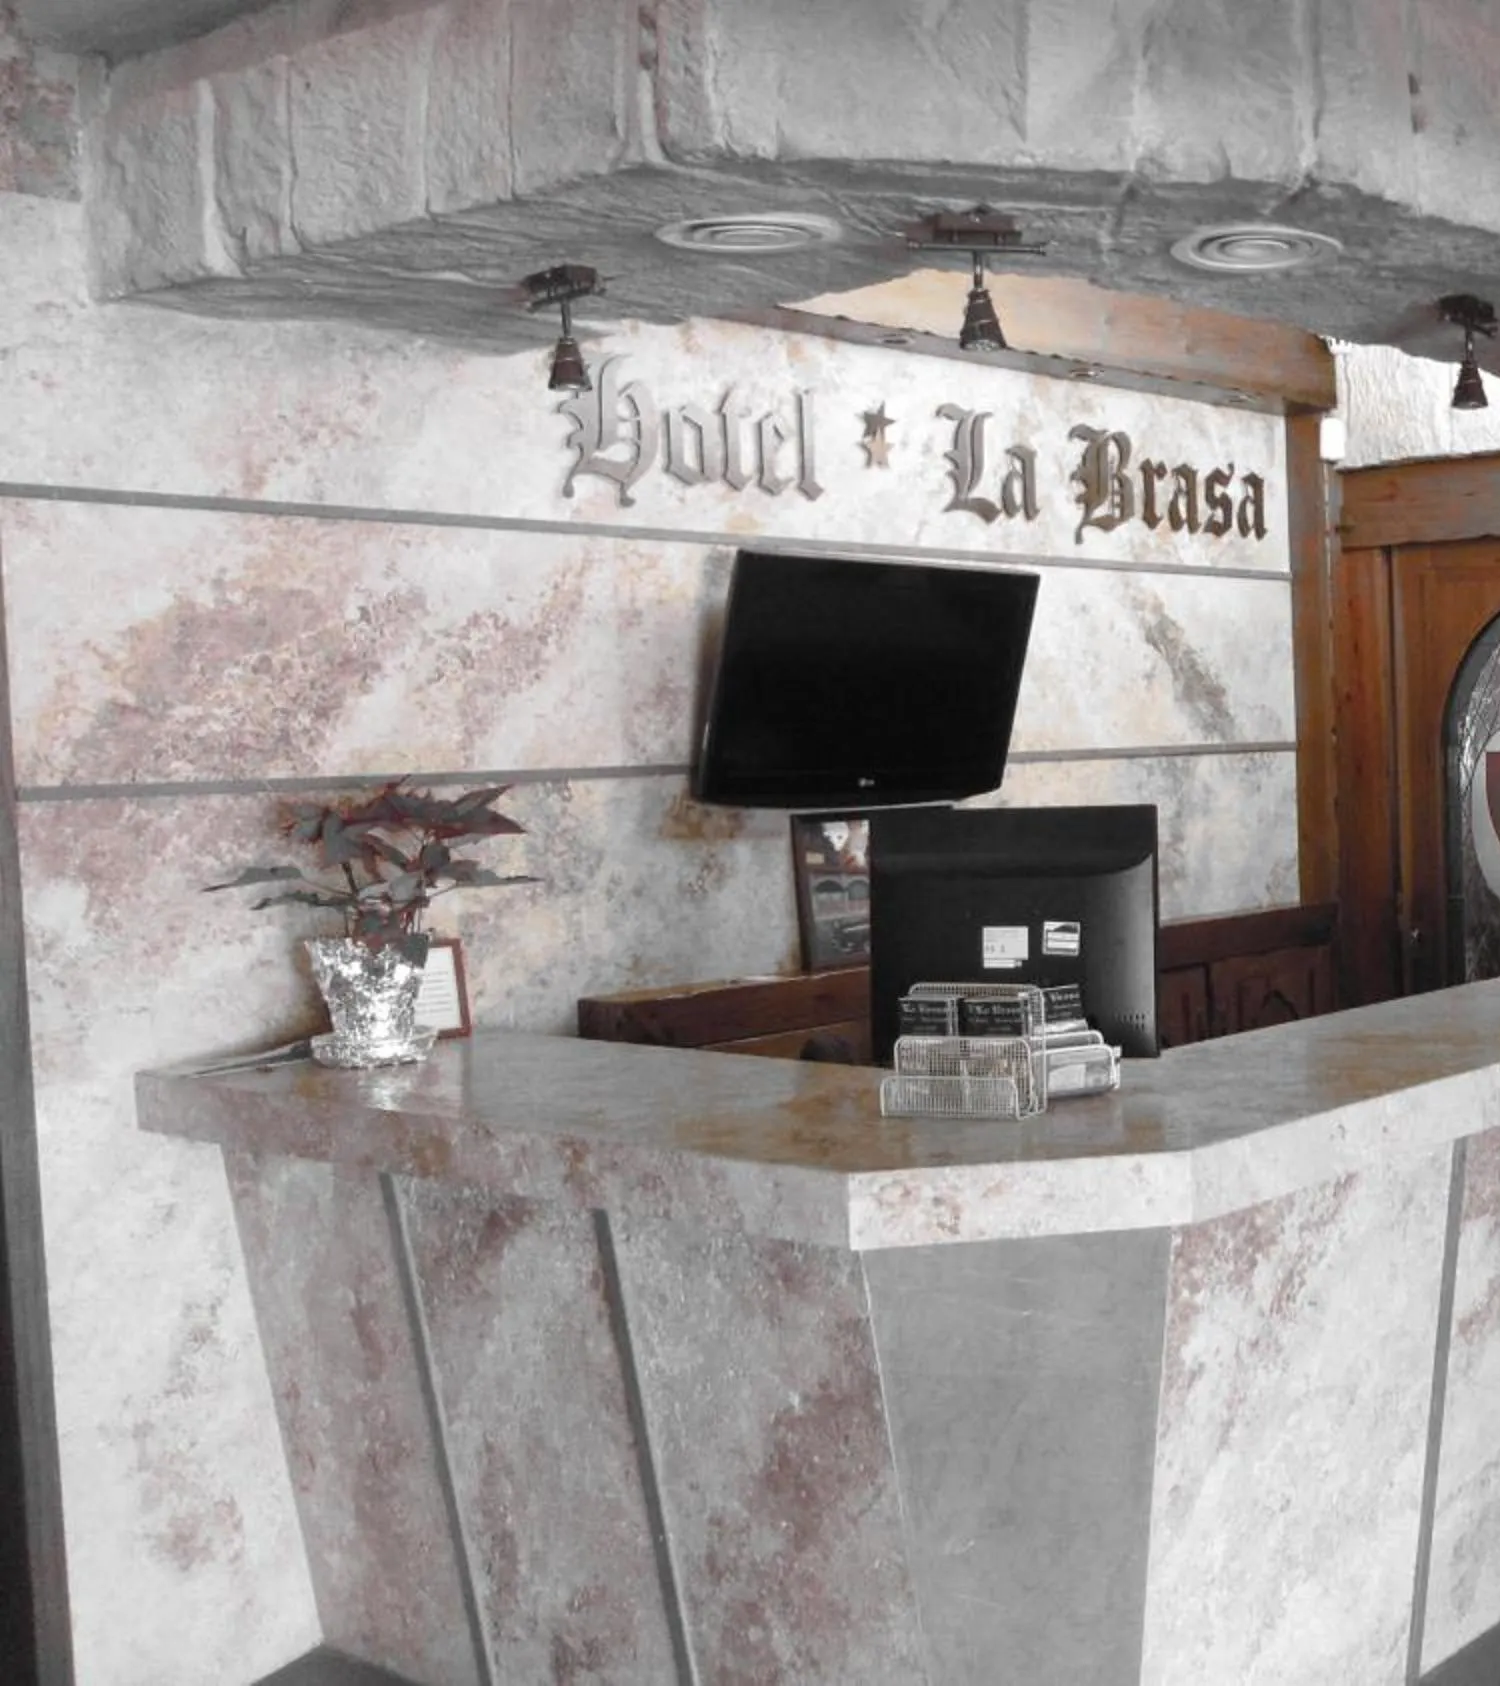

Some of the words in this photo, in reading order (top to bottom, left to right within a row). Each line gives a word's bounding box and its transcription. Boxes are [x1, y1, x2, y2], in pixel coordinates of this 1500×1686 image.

[557, 353, 825, 508] Hotel
[936, 403, 1040, 525] La
[1067, 422, 1268, 545] Brasa
